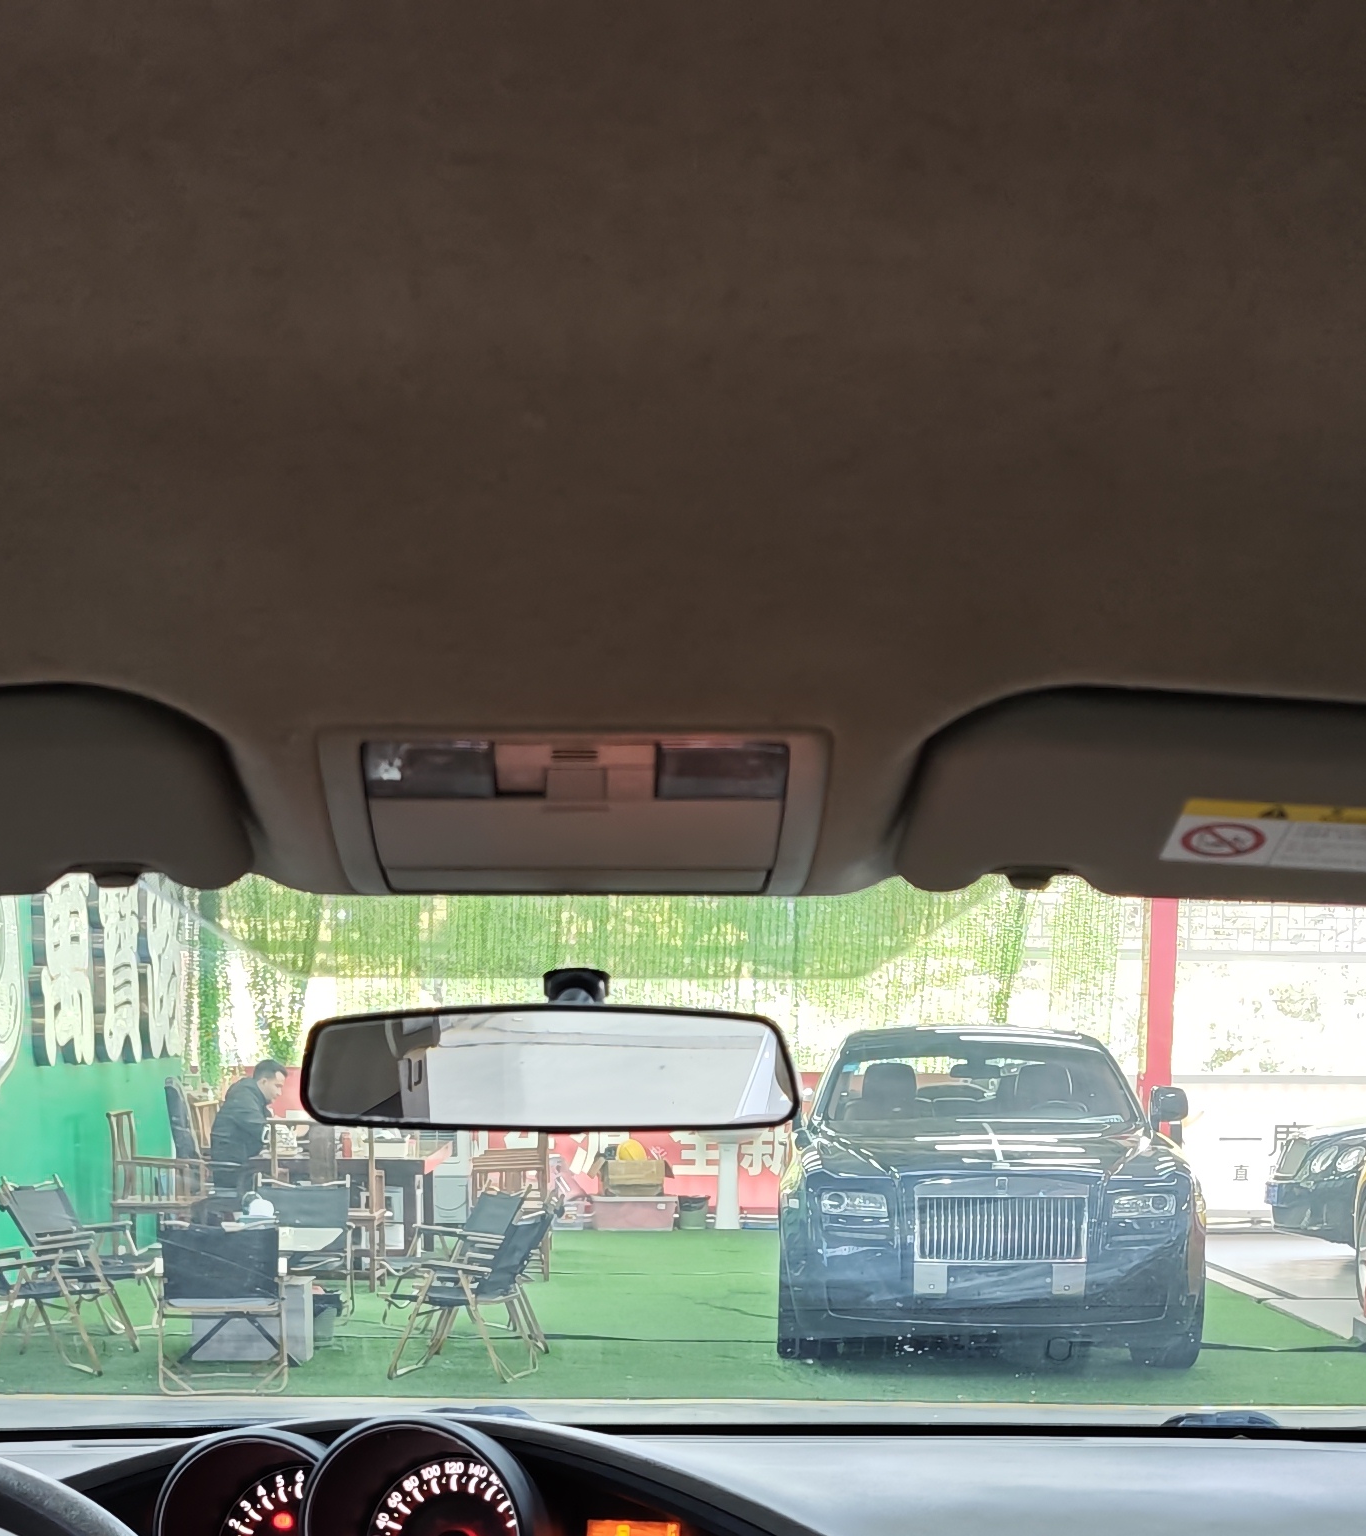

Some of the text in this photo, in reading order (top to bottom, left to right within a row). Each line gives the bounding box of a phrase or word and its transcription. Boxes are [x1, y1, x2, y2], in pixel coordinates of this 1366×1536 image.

[420, 1464, 441, 1480] 100
[444, 1461, 464, 1474] 120
[468, 1463, 488, 1477] 140
[275, 1474, 285, 1487] 5
[295, 1469, 305, 1482] 6
[402, 1475, 420, 1492] 80
[256, 1484, 267, 1497] 4
[239, 1499, 252, 1512] 3
[387, 1491, 402, 1508] 60
[228, 1518, 241, 1530] 2
[375, 1512, 390, 1530] 40
